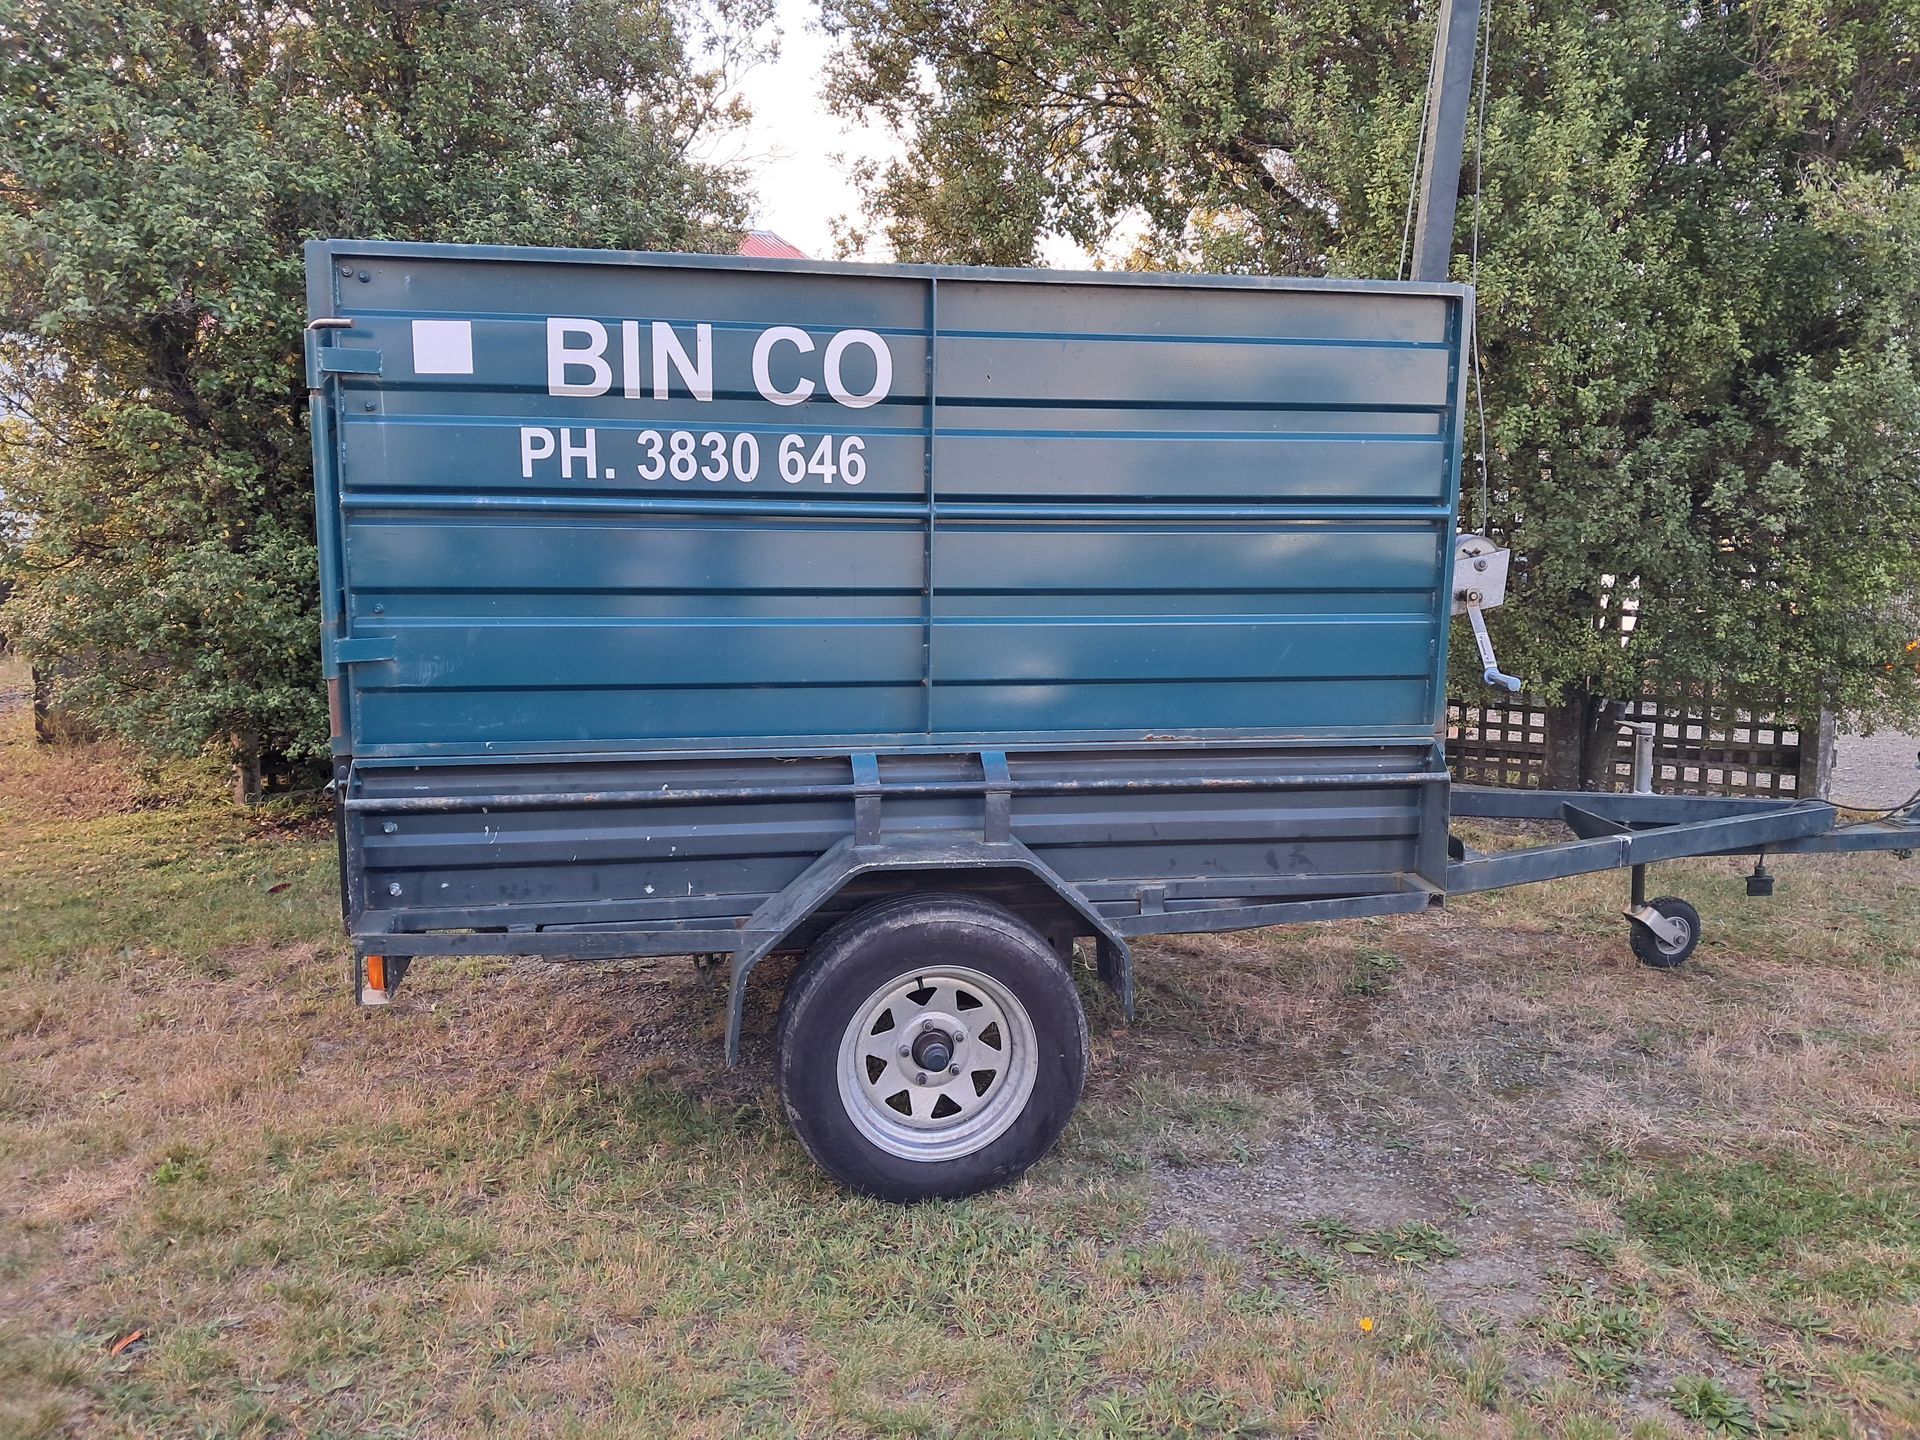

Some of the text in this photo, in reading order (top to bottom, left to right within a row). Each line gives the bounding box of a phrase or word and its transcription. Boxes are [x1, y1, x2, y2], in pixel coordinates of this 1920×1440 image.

[547, 317, 893, 409] BIN CO
[520, 427, 868, 486] PH. 3830 646
